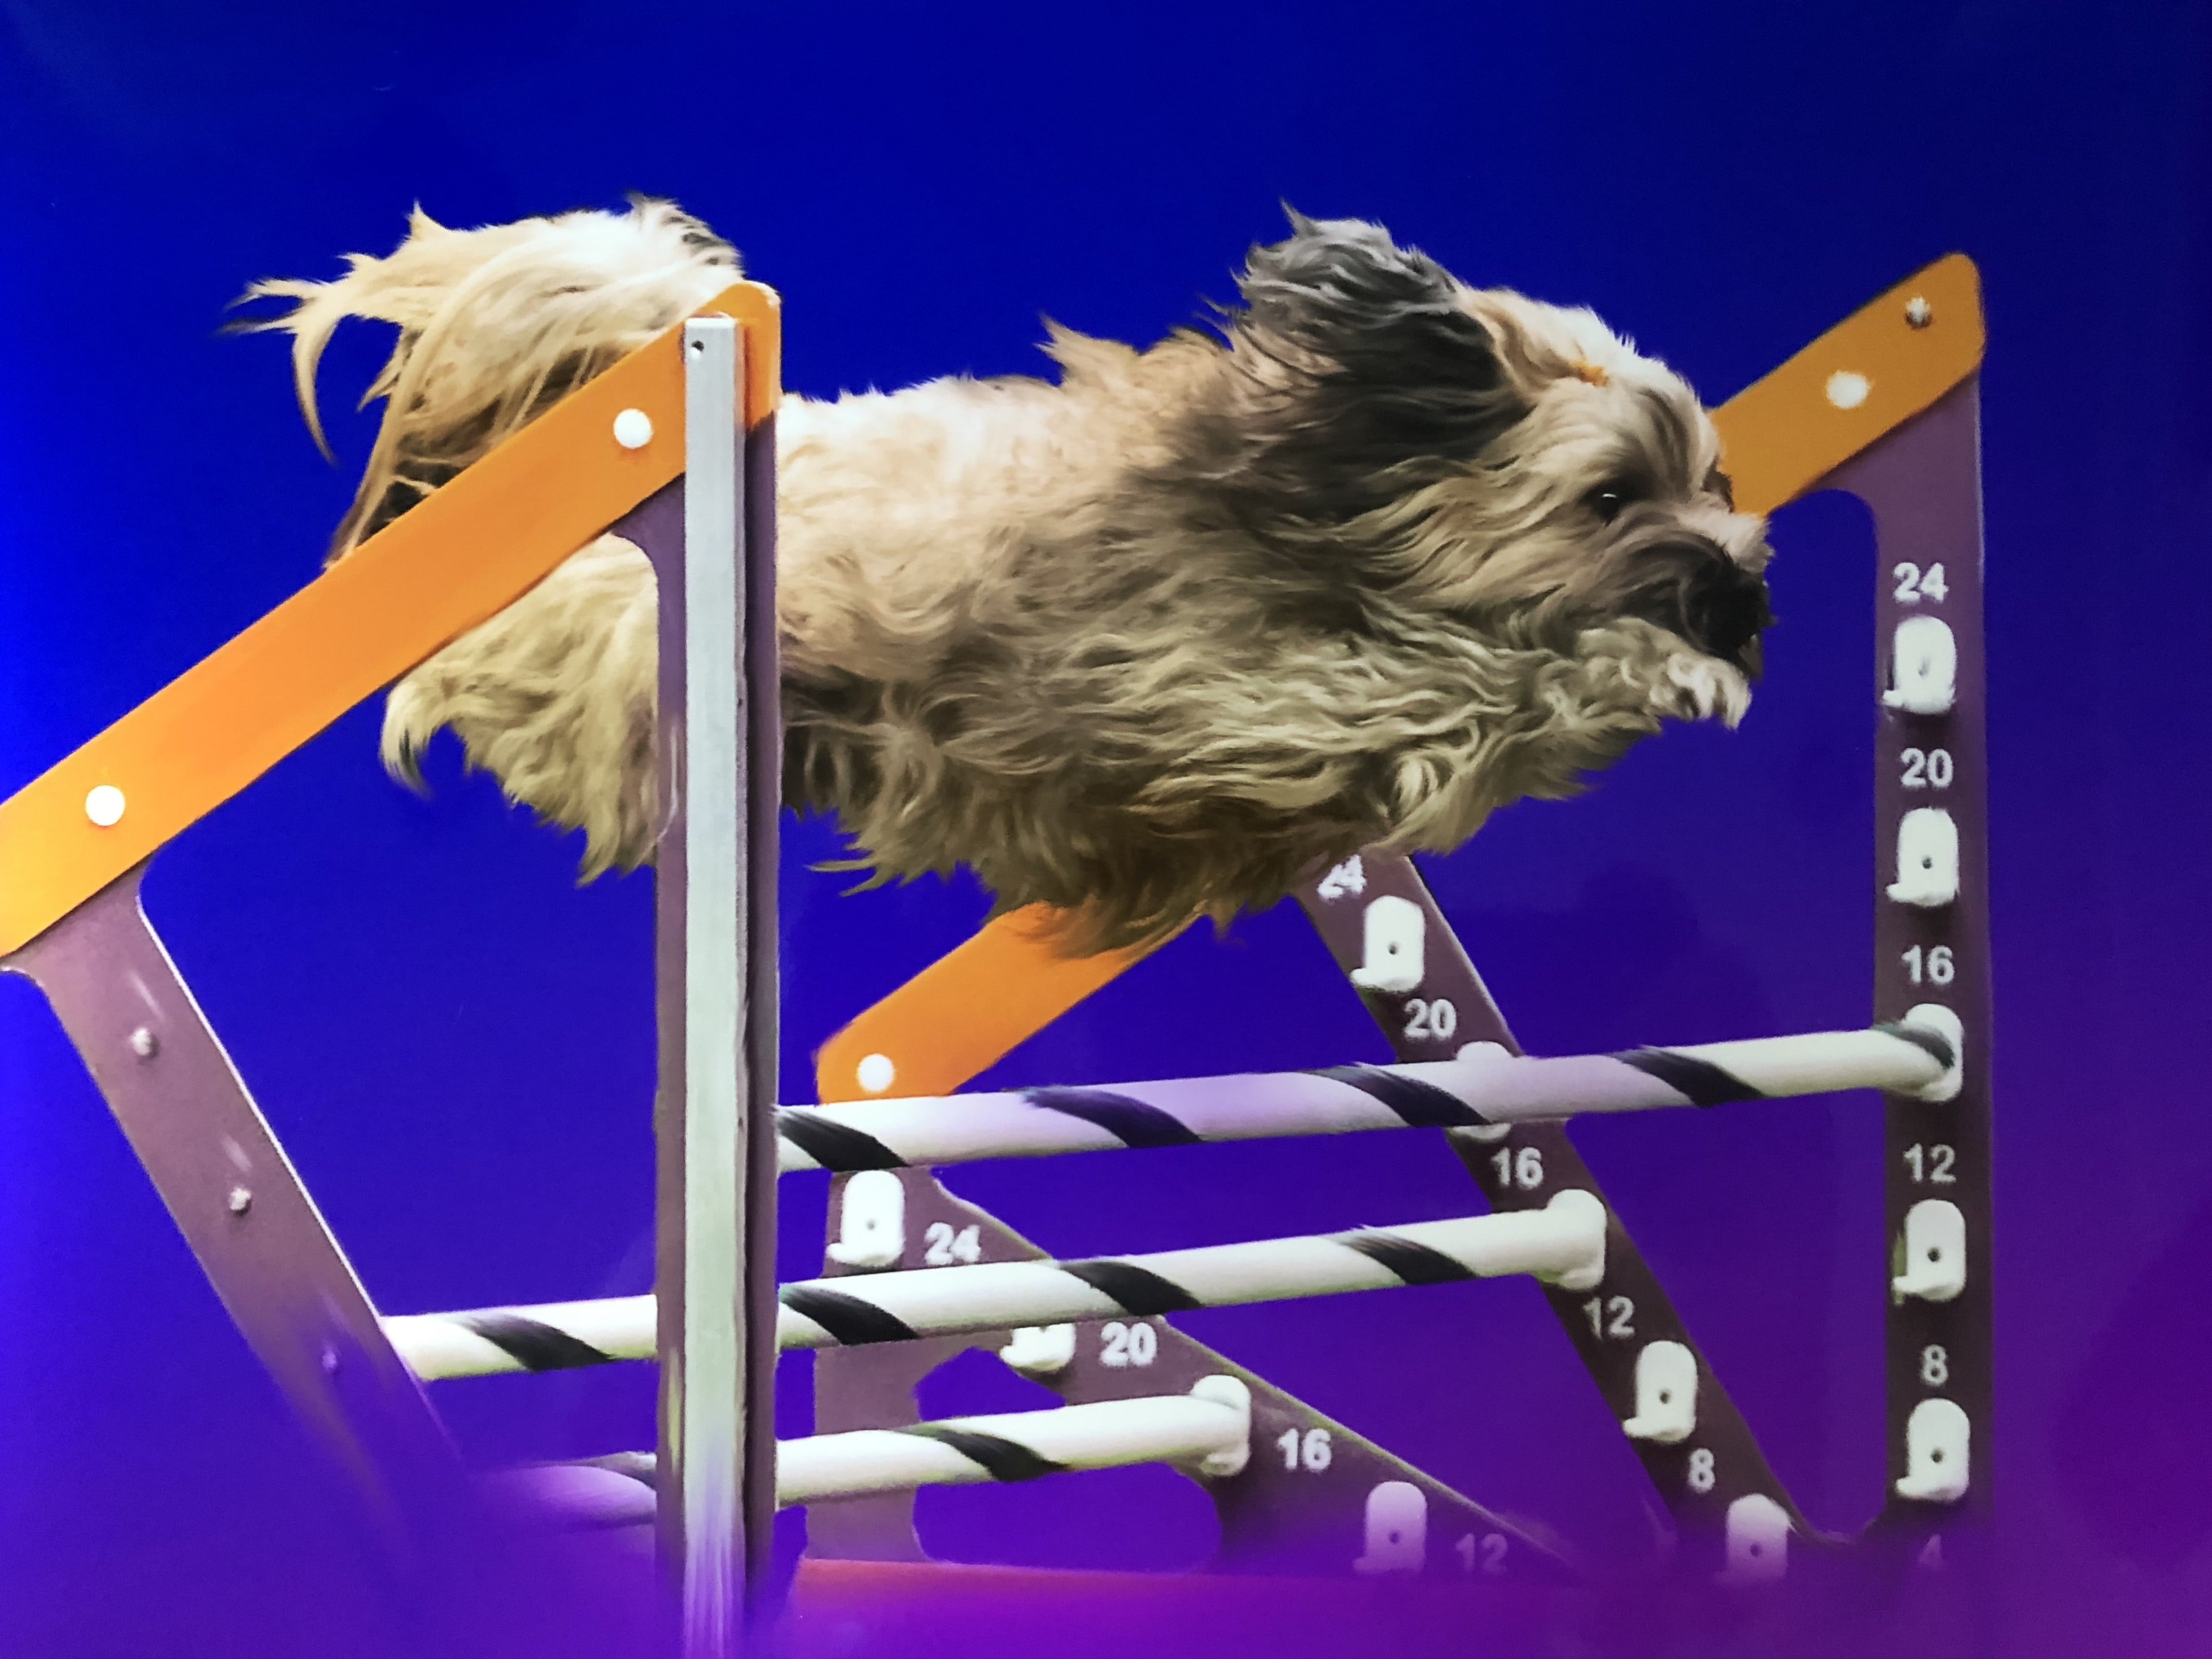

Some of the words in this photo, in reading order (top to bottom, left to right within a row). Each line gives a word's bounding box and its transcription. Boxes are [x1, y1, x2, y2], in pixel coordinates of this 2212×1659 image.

[1893, 562, 1949, 603] 24
[1900, 748, 1954, 787] 20
[1901, 945, 1955, 984] 16
[1404, 998, 1457, 1040] 20
[1491, 1147, 1544, 1189] 16
[1903, 1143, 1957, 1184] 12
[924, 1222, 981, 1265] 24
[1583, 1295, 1636, 1341] 12
[1099, 1321, 1157, 1367] 20
[1920, 1344, 1948, 1386] 8
[1277, 1428, 1332, 1472] 16
[1688, 1447, 1716, 1493] 8
[1455, 1533, 1509, 1573] 12
